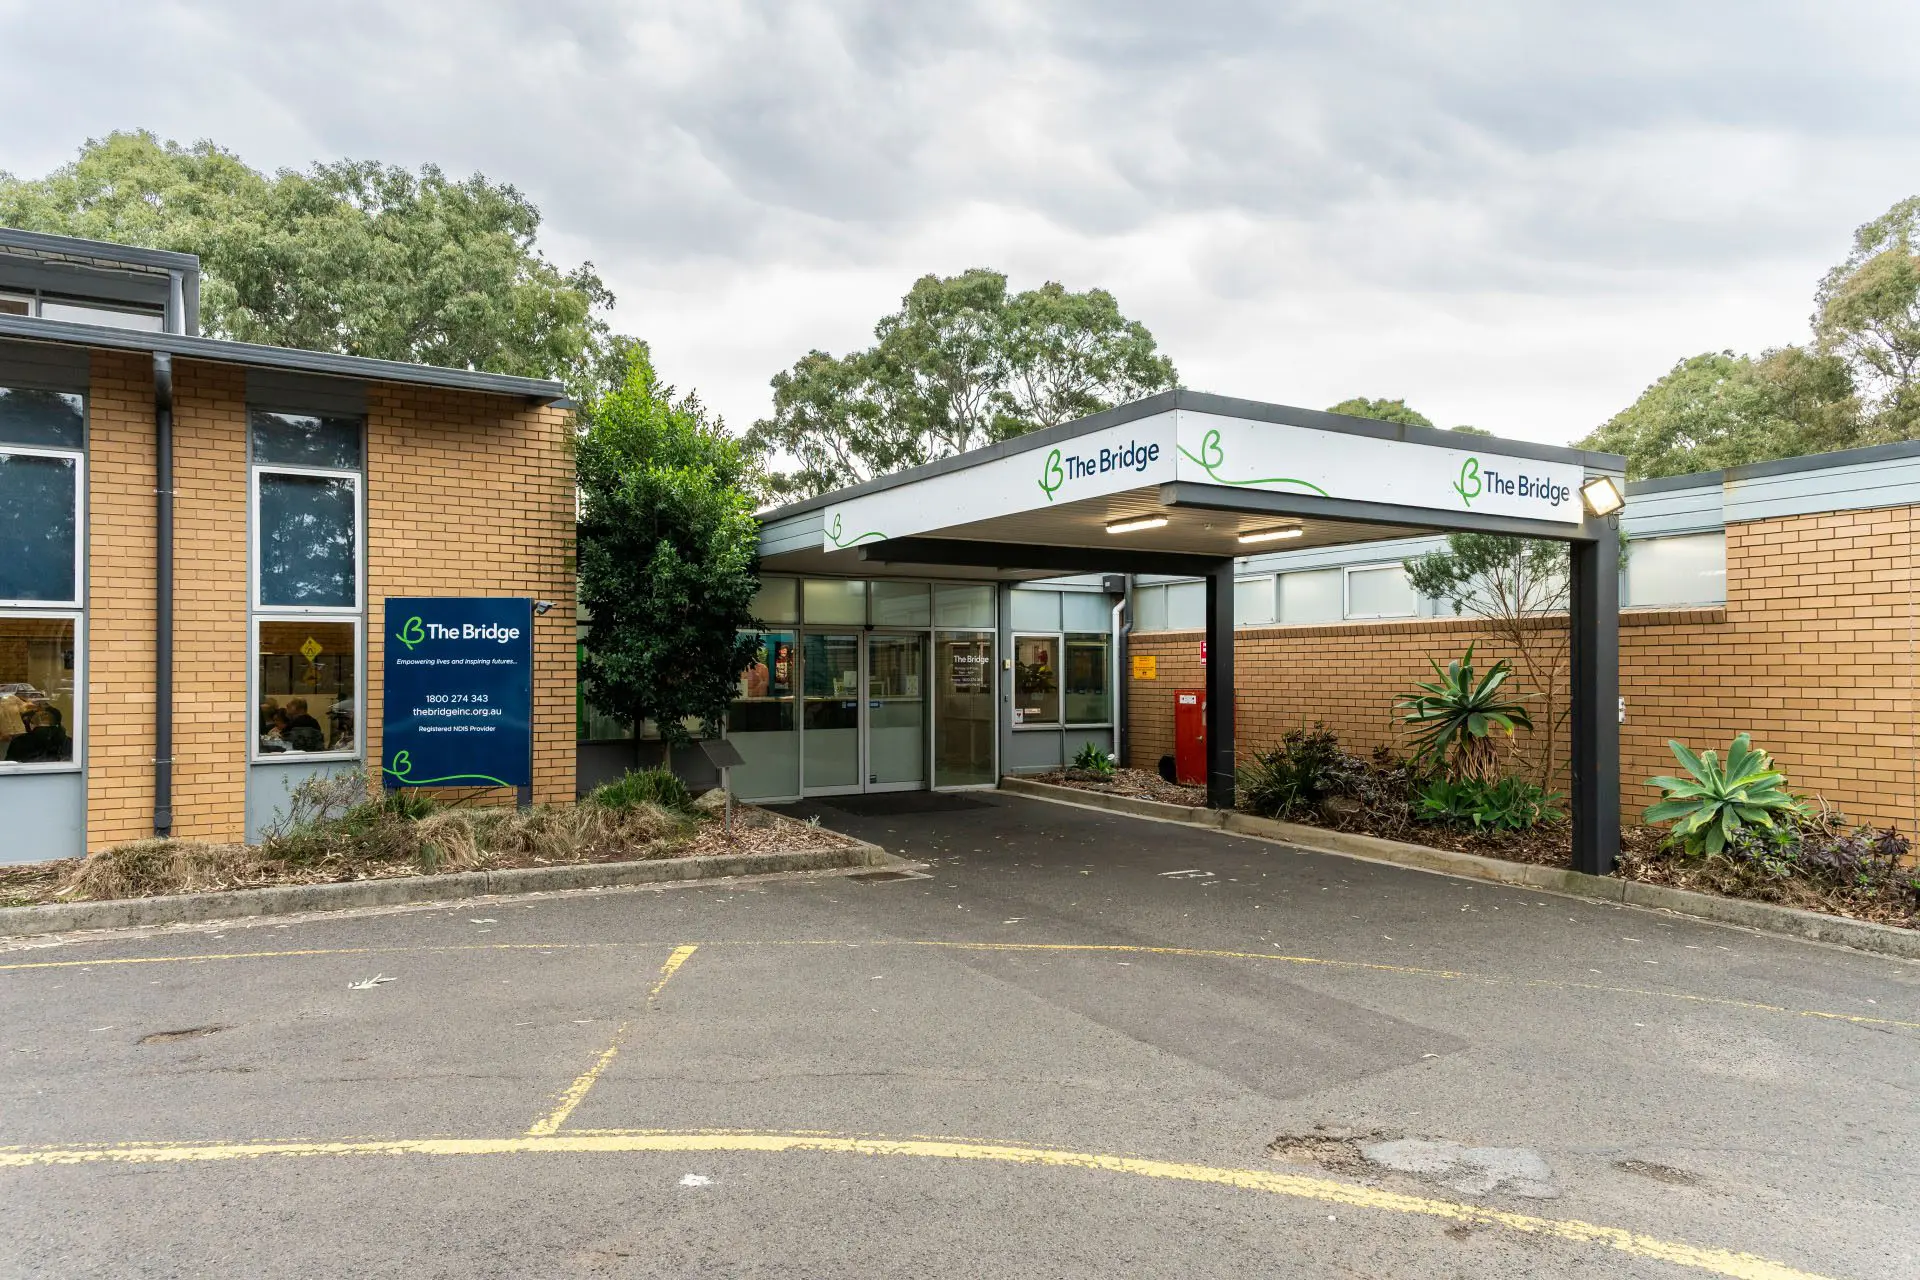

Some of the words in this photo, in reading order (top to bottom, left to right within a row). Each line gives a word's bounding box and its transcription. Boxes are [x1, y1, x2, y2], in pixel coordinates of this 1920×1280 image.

[1066, 456, 1096, 480] The
[1100, 440, 1159, 473] Bridge
[1484, 470, 1514, 495] The
[1519, 475, 1569, 506] Bridge
[427, 623, 459, 639] The
[463, 622, 519, 643] Bridge
[967, 655, 989, 664] Bridge
[426, 695, 448, 703] 1800
[452, 695, 468, 703] 274
[471, 695, 488, 703] 343
[413, 708, 502, 716] thebridgeinc.org.au
